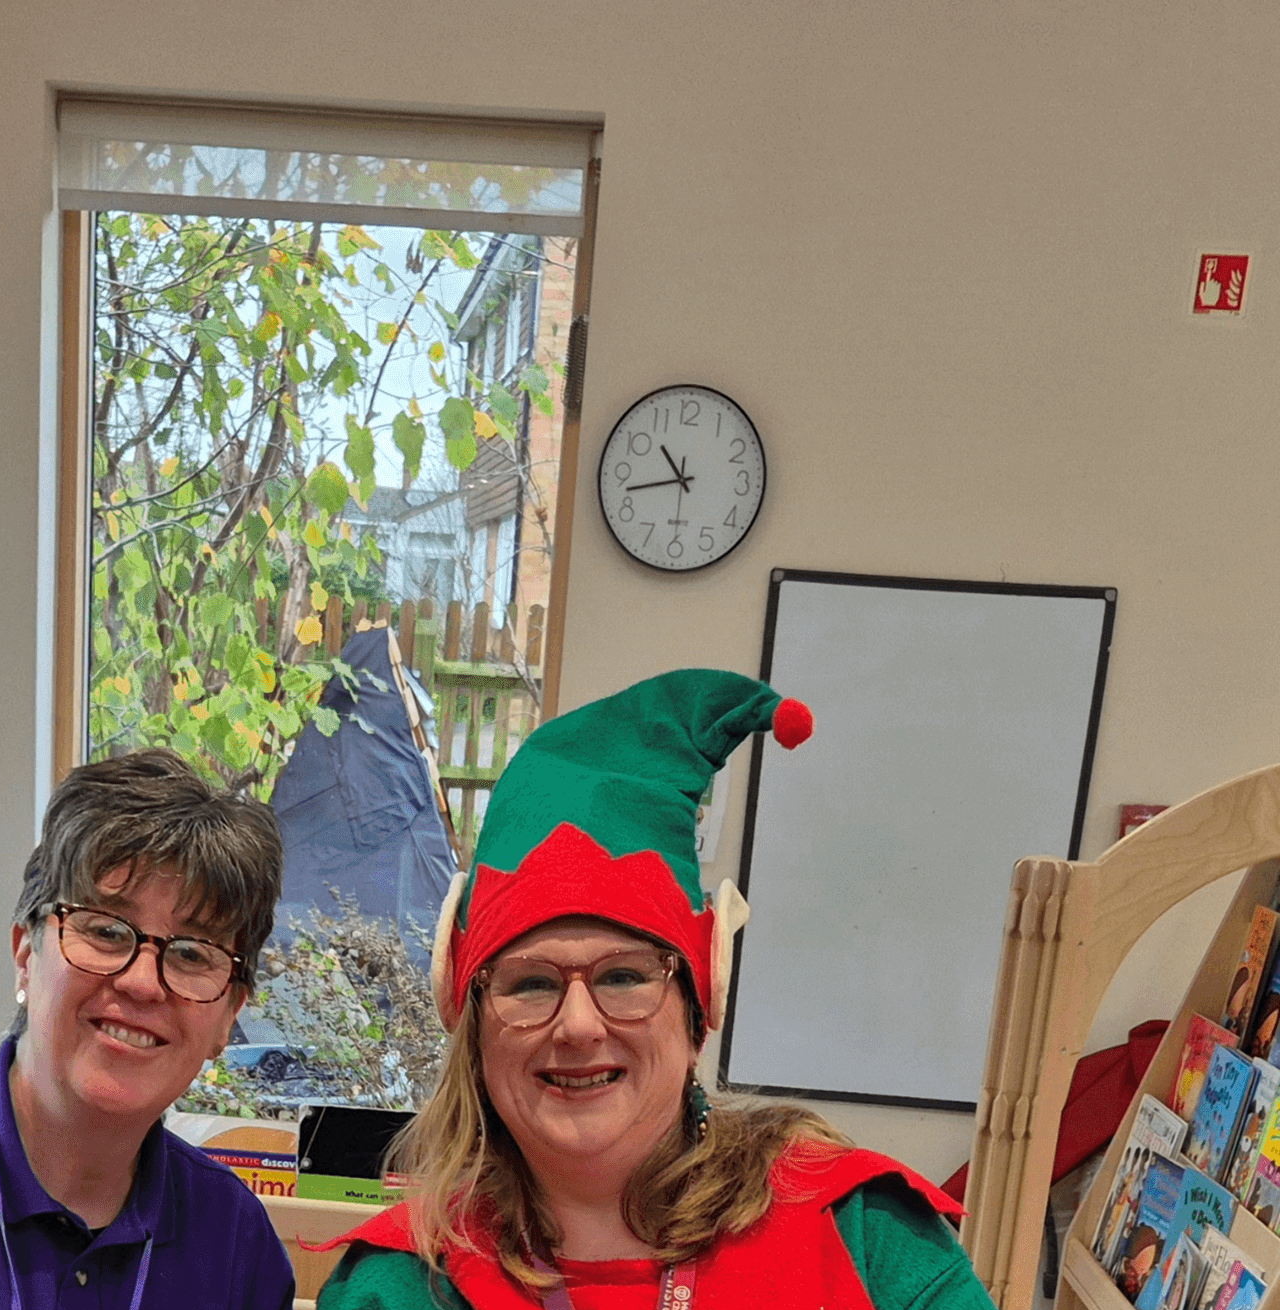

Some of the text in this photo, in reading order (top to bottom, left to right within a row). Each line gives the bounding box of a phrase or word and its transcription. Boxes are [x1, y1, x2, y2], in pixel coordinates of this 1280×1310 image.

[653, 407, 670, 433] 11
[679, 399, 701, 427] 12
[716, 412, 722, 438] 1
[626, 431, 652, 456] 10
[728, 437, 747, 464] 2
[614, 461, 632, 488] 9
[734, 469, 750, 497] 3
[618, 496, 635, 523] 8
[723, 504, 738, 528] 4
[640, 522, 656, 548] 7
[666, 534, 684, 559] 6
[698, 526, 714, 552] 5
